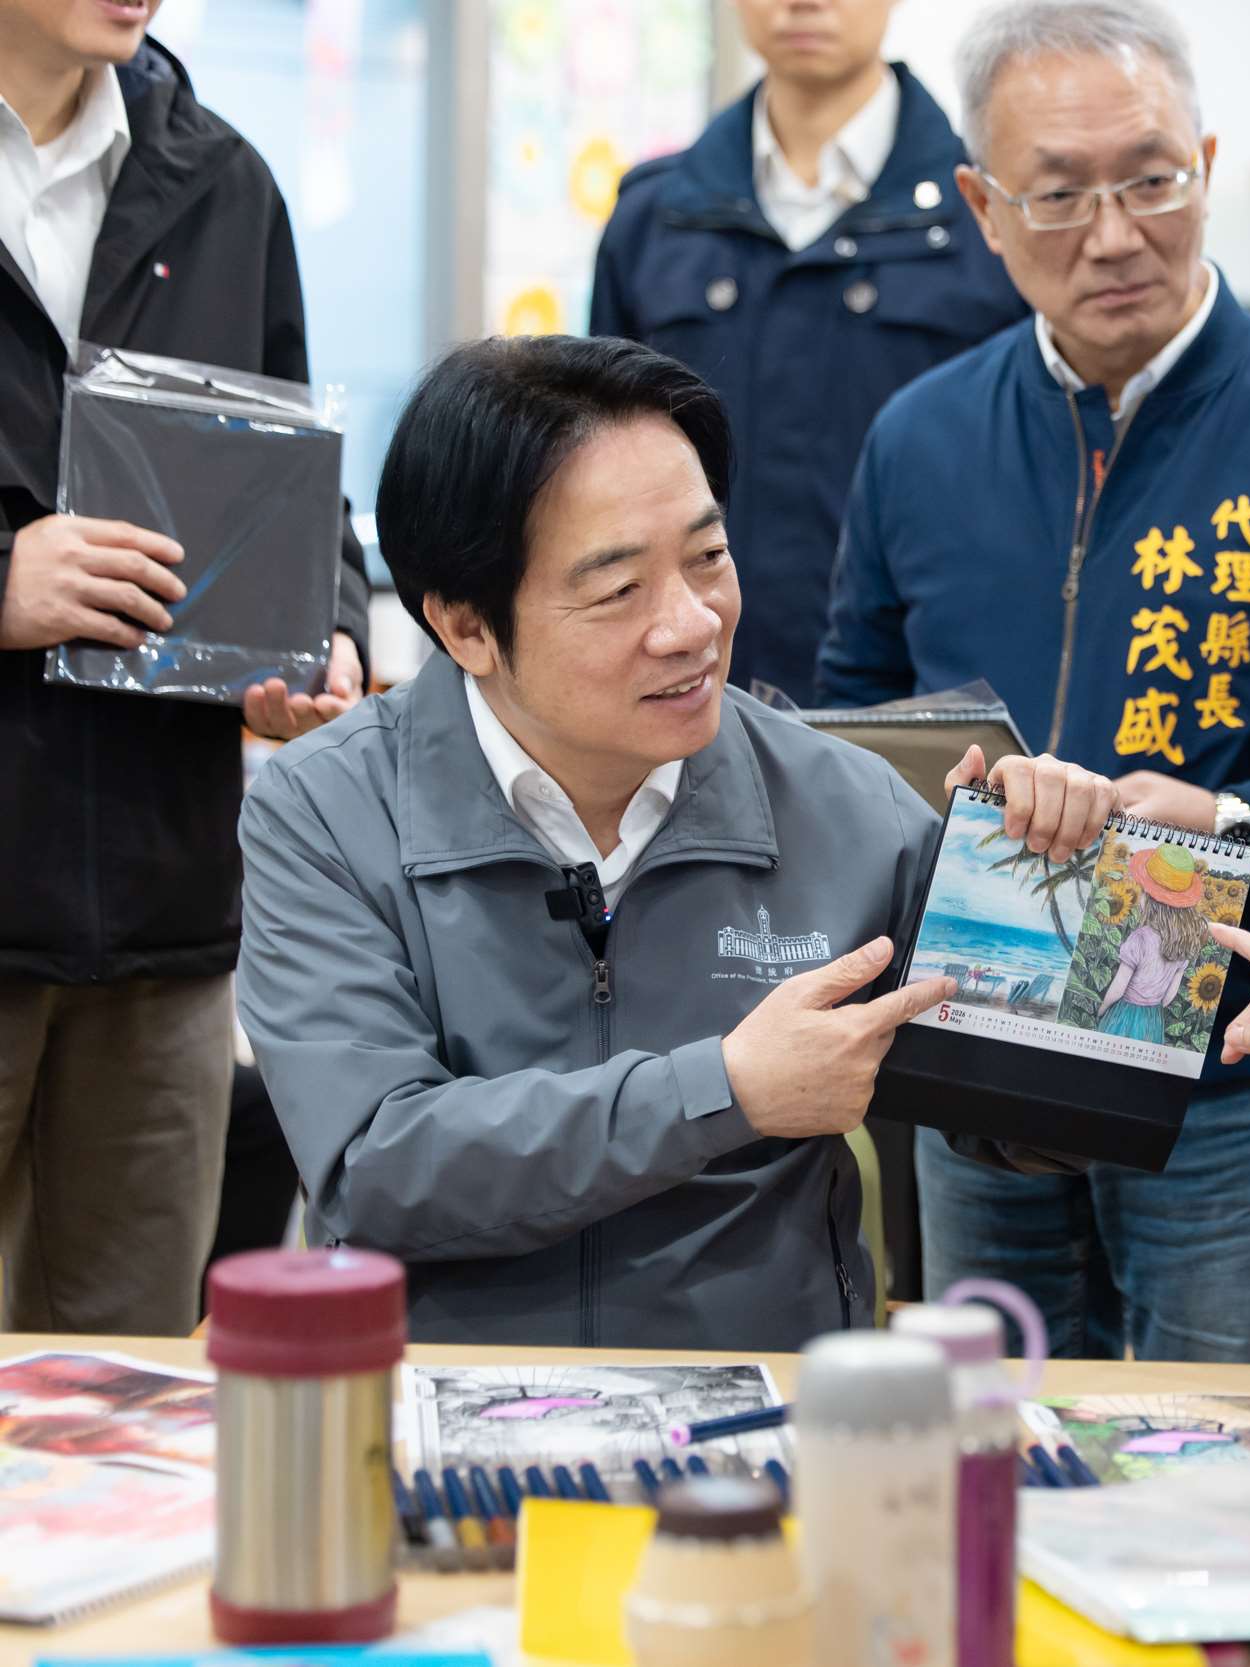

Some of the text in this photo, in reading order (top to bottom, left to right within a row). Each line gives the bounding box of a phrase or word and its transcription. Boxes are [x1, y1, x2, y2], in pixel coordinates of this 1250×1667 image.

[1114, 525, 1204, 767] 林茂盛
[938, 1004, 950, 1022] 5
[951, 1009, 966, 1017] 2026
[950, 1016, 963, 1025] May
